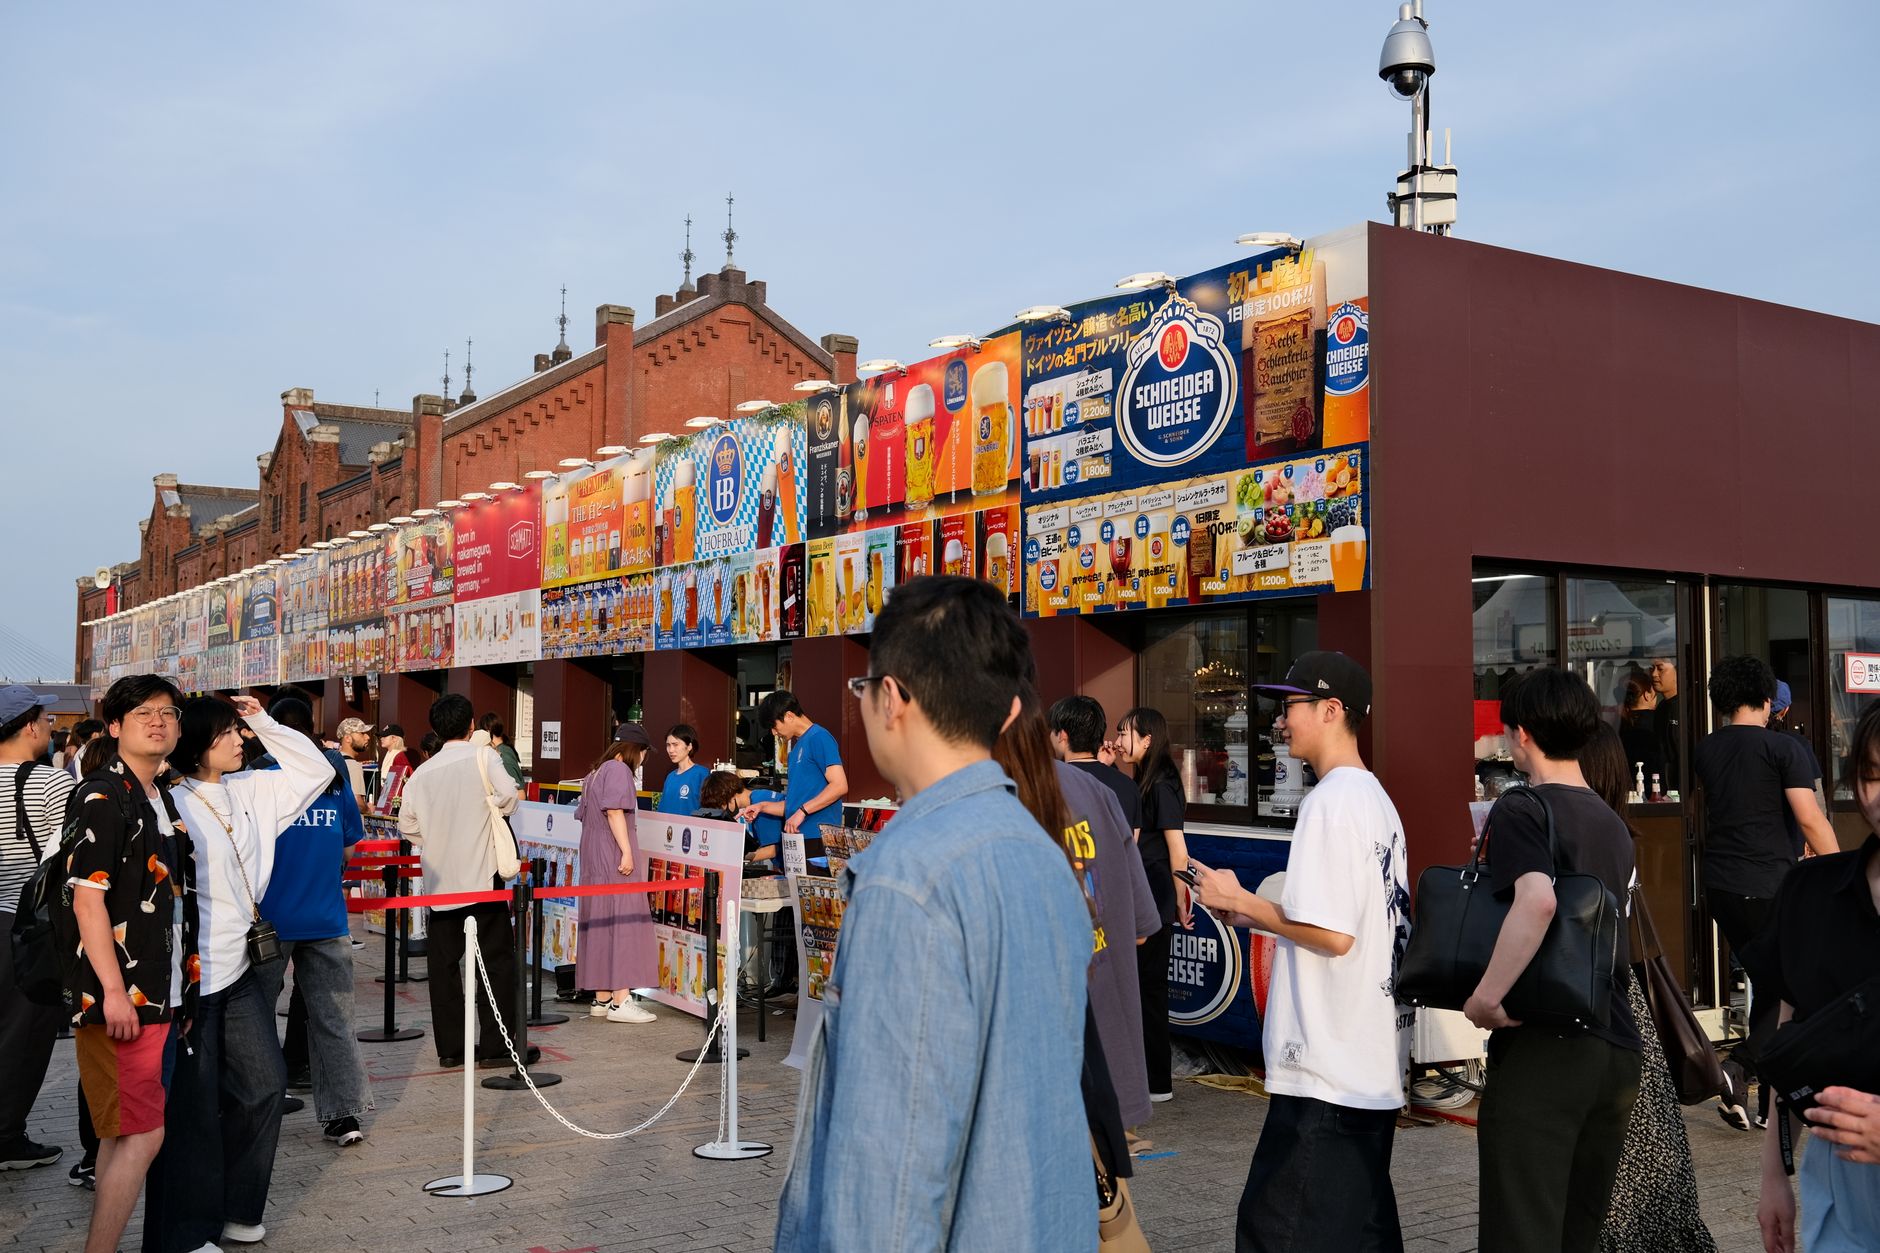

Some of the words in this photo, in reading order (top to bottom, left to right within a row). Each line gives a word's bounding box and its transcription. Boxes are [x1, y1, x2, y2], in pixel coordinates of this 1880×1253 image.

[1227, 284, 1313, 323] 1日限定100杯!!
[1025, 300, 1155, 354] ヴァイツェン醸造で名高い
[1026, 329, 1141, 377] ドイツの名門ブルワリー
[1328, 358, 1363, 378] WEISSE
[1135, 369, 1214, 409] SCHNEIDER
[874, 411, 904, 427] SPATEN
[1148, 397, 1201, 430] WEISSE
[810, 441, 838, 454] Franziskaner
[715, 476, 735, 512] HB
[1195, 510, 1220, 524] 1日限定
[470, 529, 475, 541] in
[1206, 521, 1238, 537] 100杯!!
[704, 527, 747, 551] HOFBRÄU
[1237, 547, 1284, 562] フルーツ&白ビール
[457, 562, 476, 577] brewed
[477, 560, 482, 573] in
[1254, 560, 1266, 569] 各種
[1868, 674, 1880, 682] 立入
[291, 809, 337, 827] AFF
